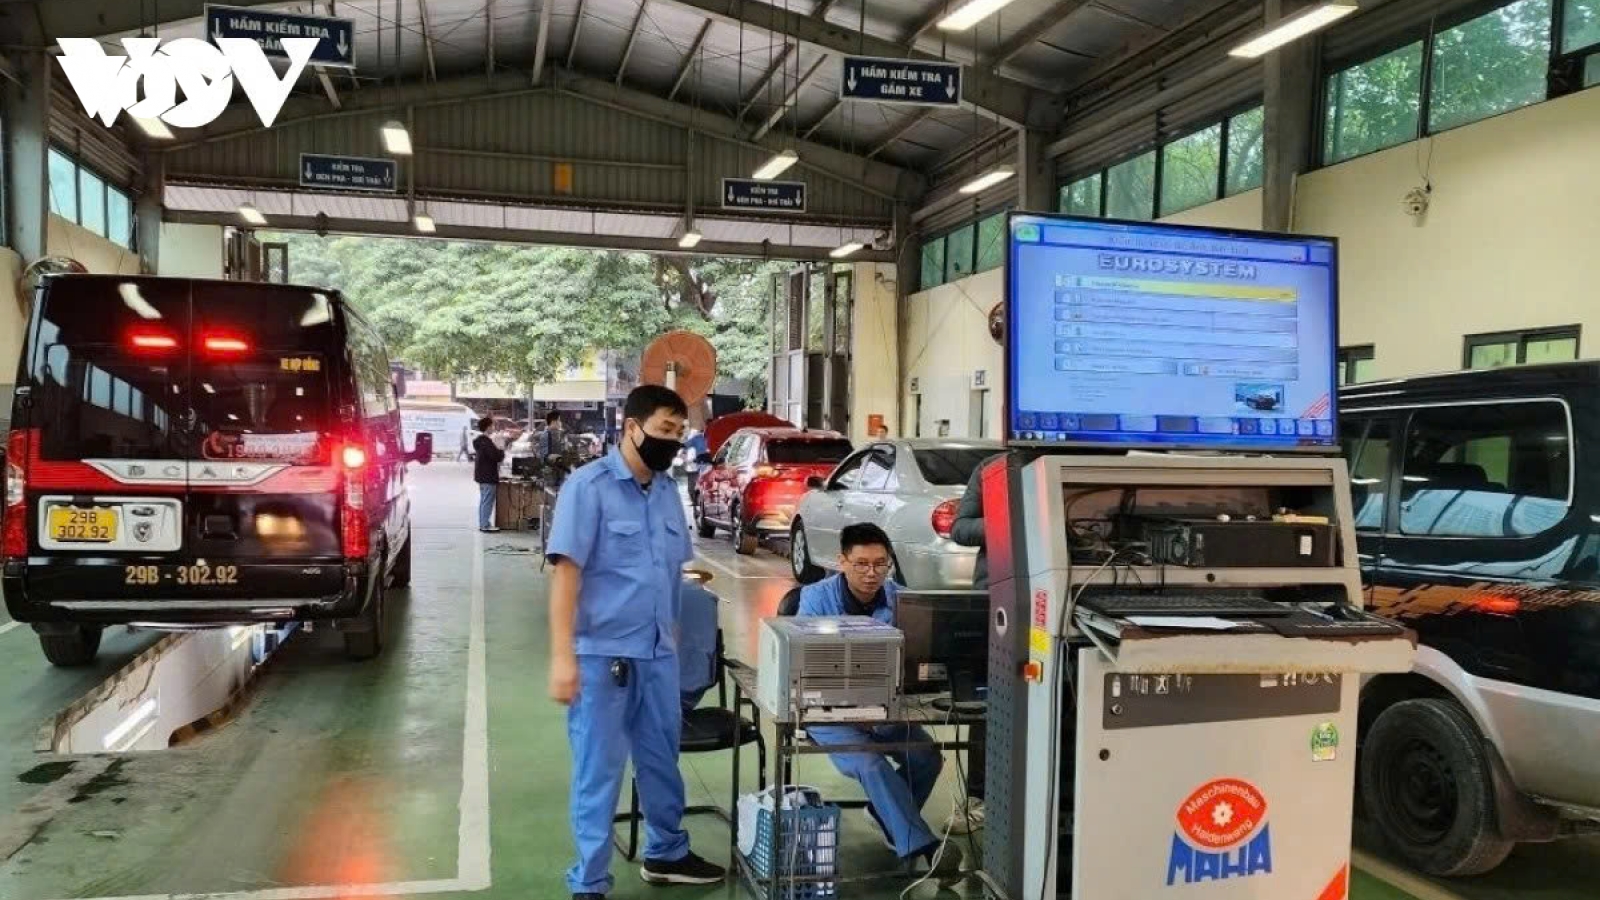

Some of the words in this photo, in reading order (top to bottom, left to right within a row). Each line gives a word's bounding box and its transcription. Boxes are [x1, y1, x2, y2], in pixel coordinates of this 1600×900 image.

[304, 25, 329, 38] TRA
[921, 71, 942, 83] TRA
[909, 86, 924, 97] XE
[1098, 252, 1257, 280] EUROSYSTEM
[70, 511, 97, 525] 29B
[57, 525, 110, 540] 302.92
[125, 565, 159, 585] 29B
[176, 565, 239, 585] 302.92
[1185, 783, 1261, 815] Maschinenbau
[1166, 821, 1273, 887] MAHA
